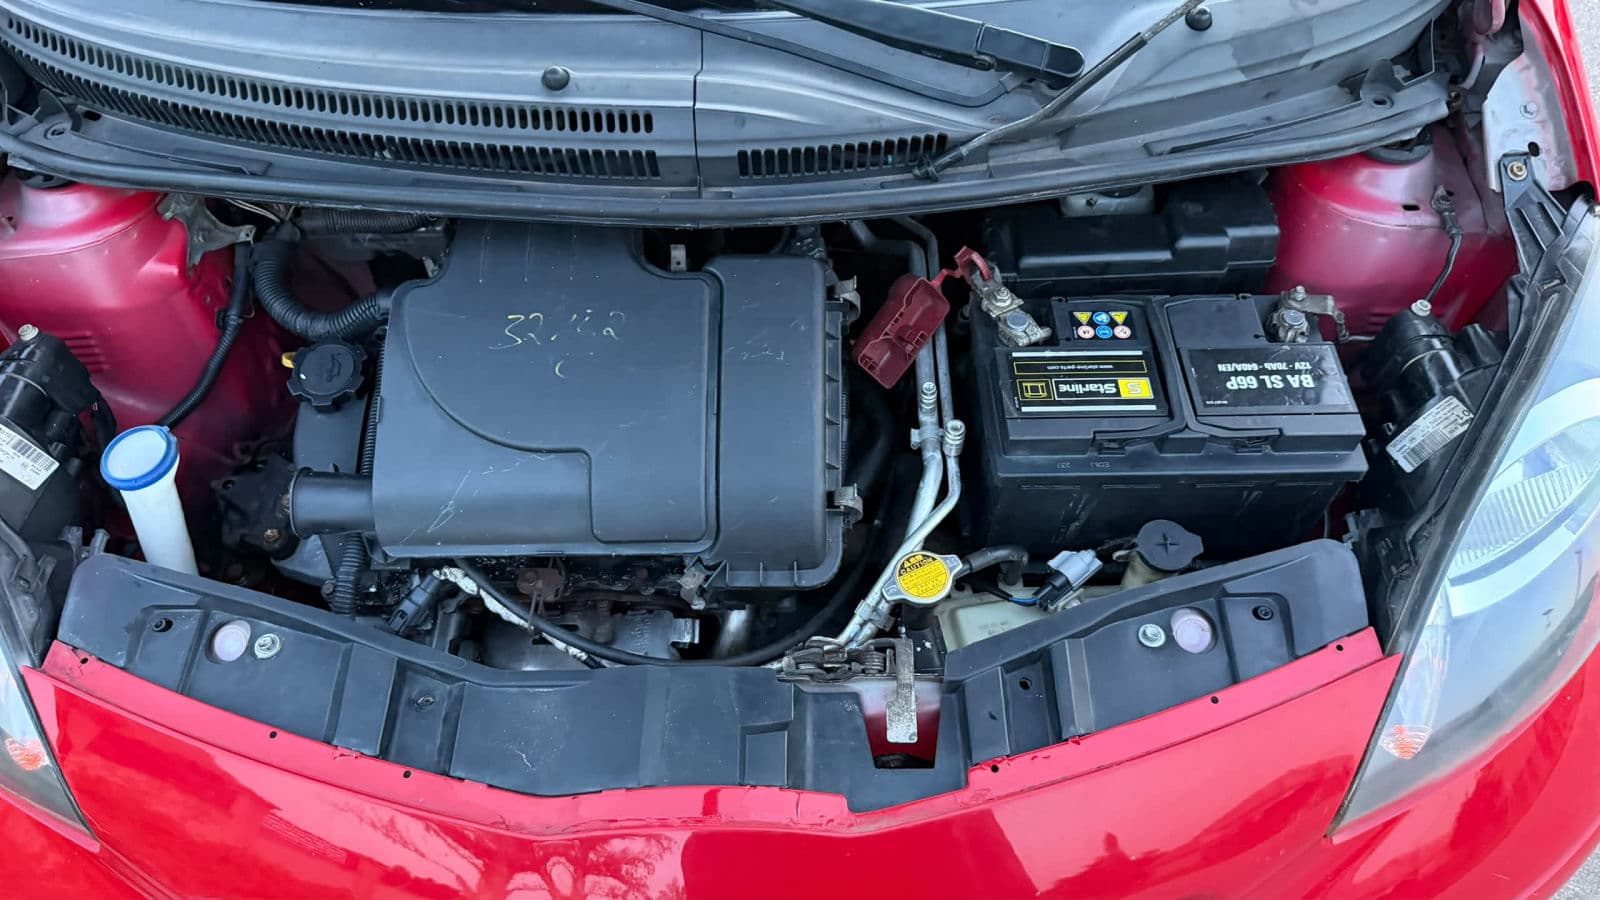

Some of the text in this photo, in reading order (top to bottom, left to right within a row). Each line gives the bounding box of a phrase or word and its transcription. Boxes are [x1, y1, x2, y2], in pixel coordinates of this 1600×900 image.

[1217, 361, 1312, 373] 12V 70Ah 640A/EN
[1058, 383, 1117, 395] Starline
[1226, 374, 1315, 390] BA SL 66P
[900, 557, 935, 575] CAUTION
